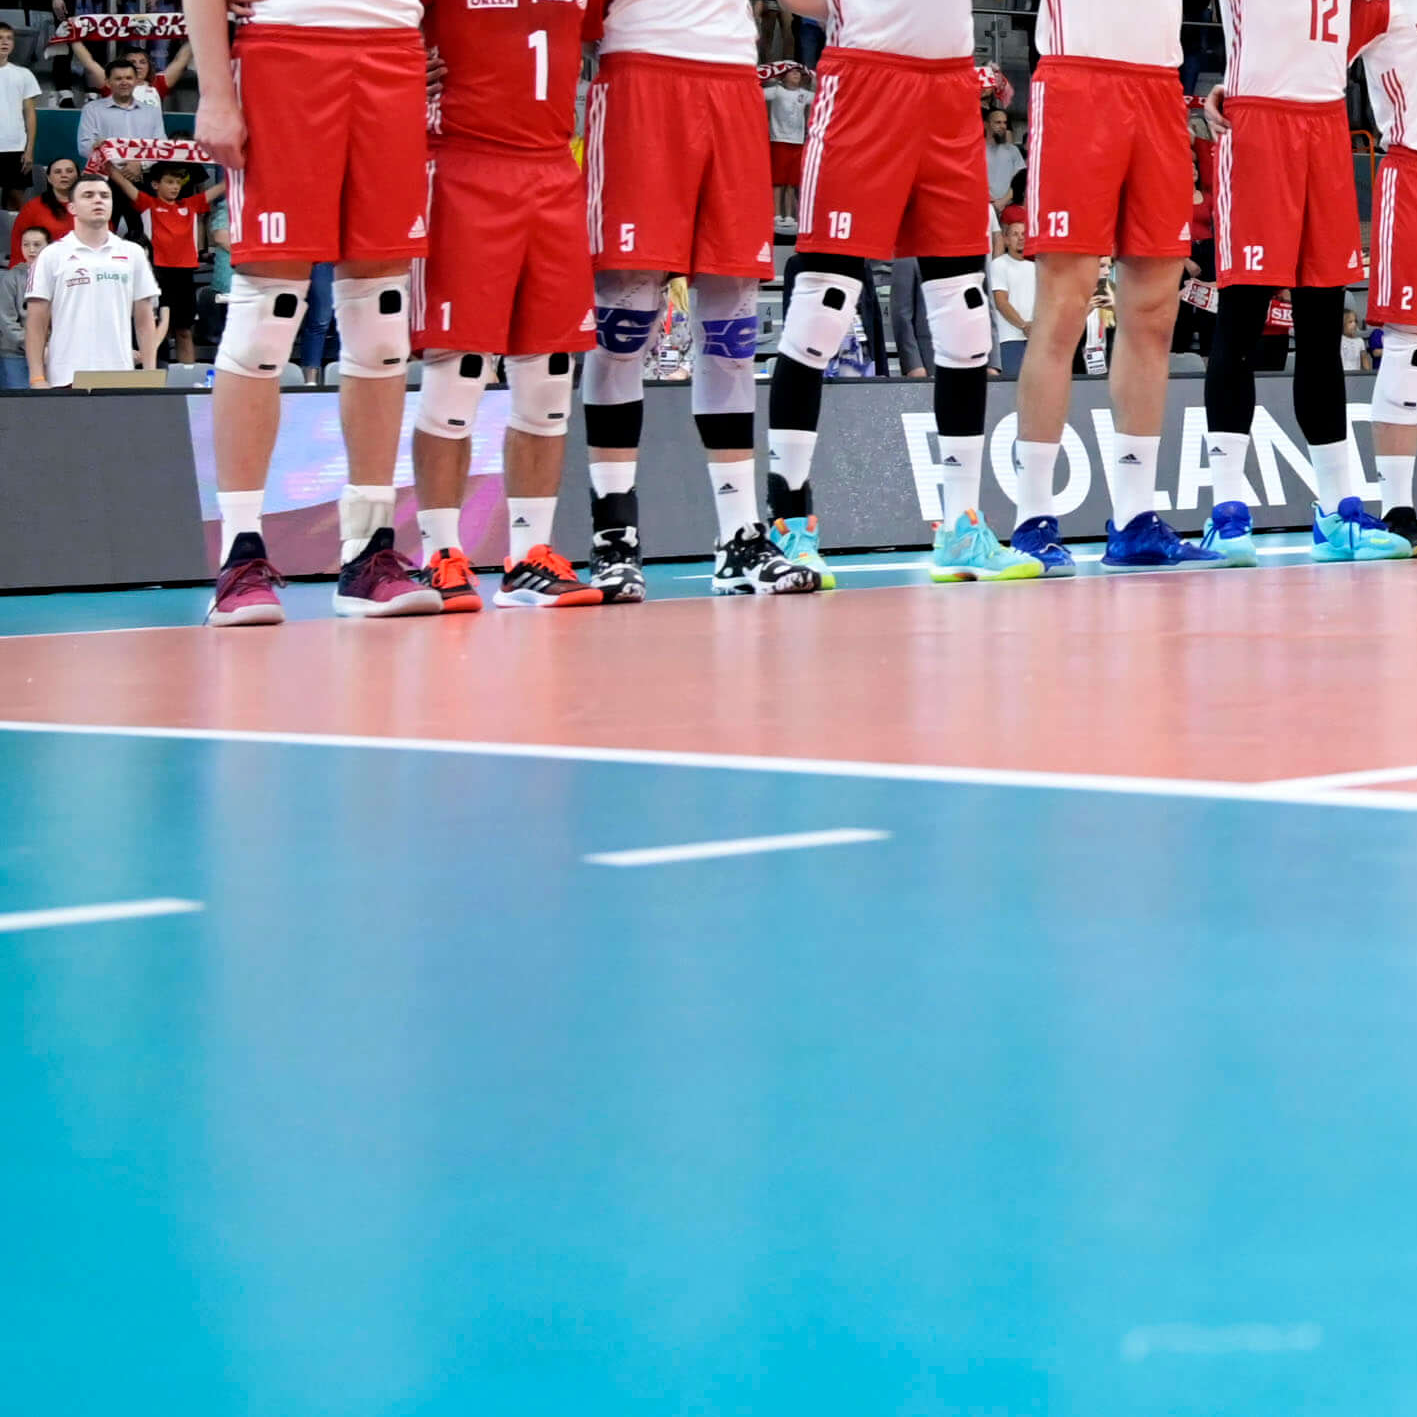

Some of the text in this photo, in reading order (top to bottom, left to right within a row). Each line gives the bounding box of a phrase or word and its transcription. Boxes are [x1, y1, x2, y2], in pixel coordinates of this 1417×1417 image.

[527, 30, 548, 101] 1
[258, 212, 286, 244] 10
[619, 223, 635, 252] 5
[828, 211, 851, 239] 19
[1047, 211, 1069, 237] 13
[1243, 246, 1264, 271] 12
[96, 272, 119, 282] plus
[1400, 286, 1413, 310] 2
[440, 302, 452, 332] 1
